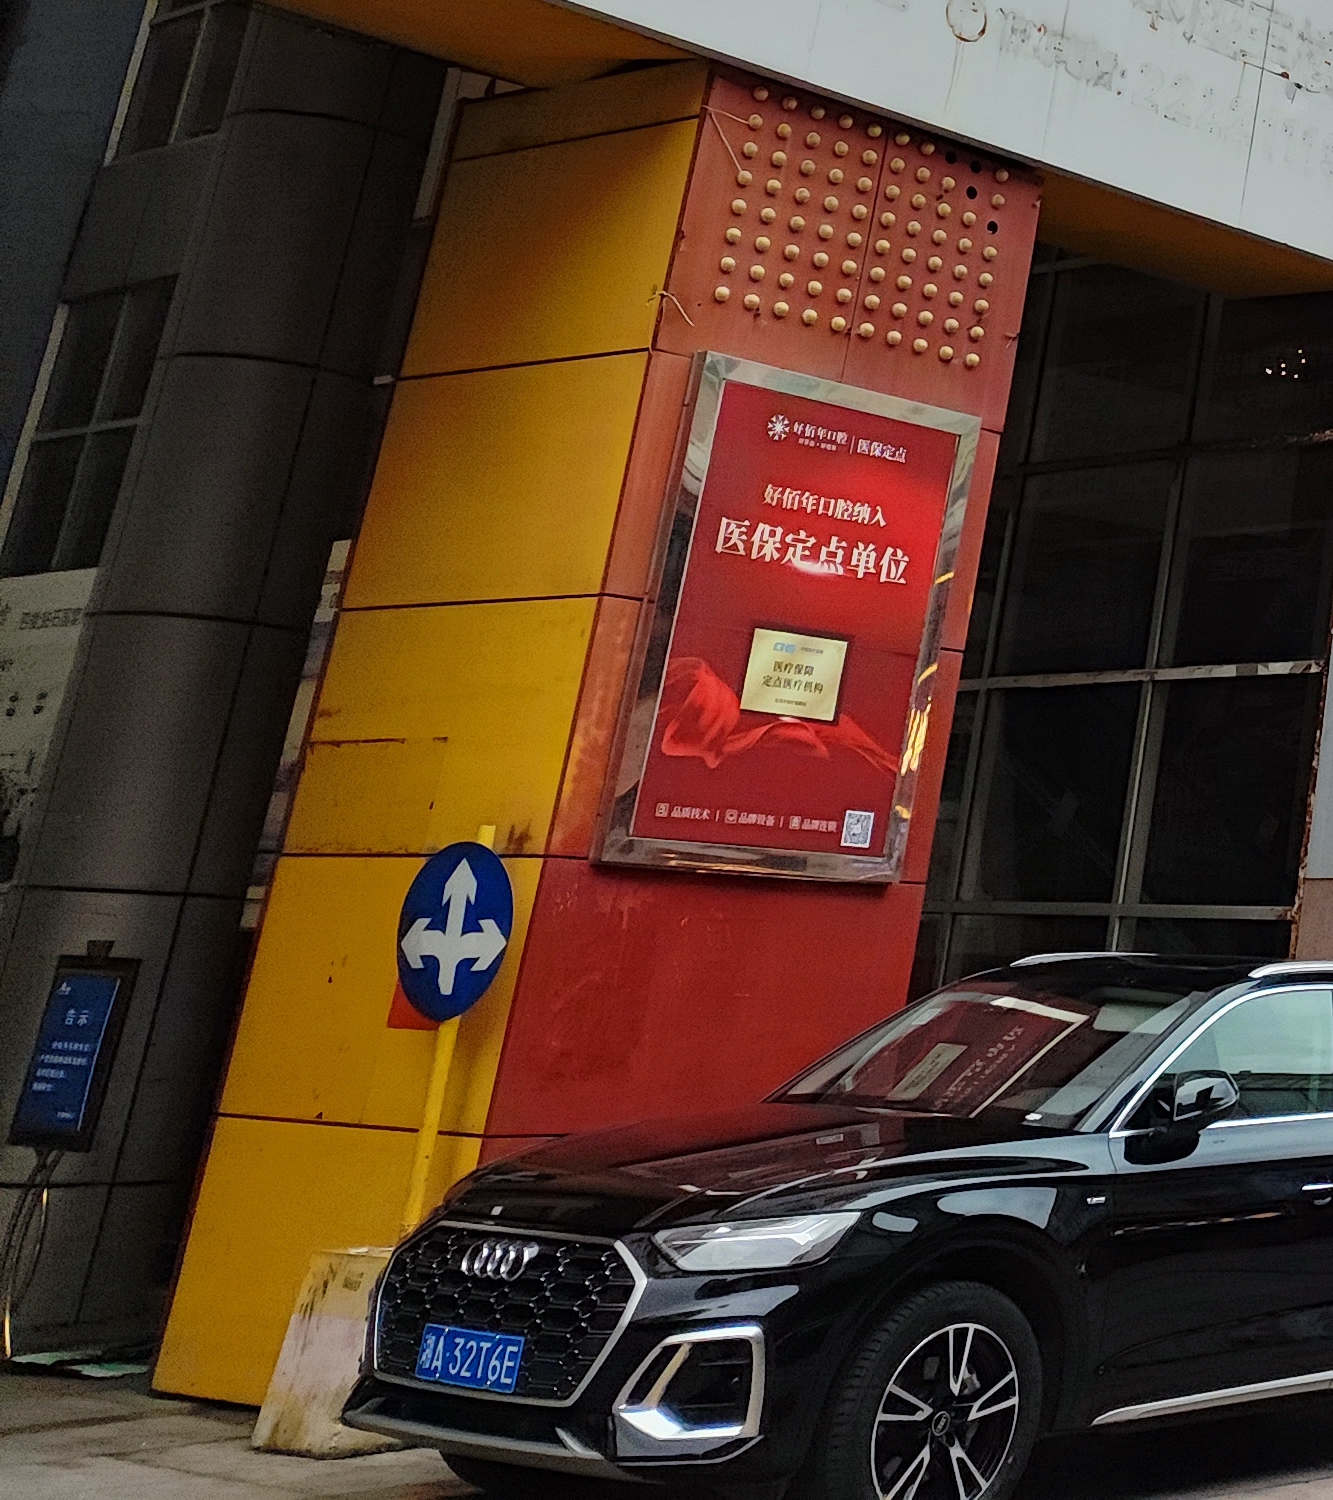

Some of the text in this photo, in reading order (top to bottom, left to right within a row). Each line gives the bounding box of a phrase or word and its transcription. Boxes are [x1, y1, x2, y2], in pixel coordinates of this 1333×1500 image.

[762, 484, 887, 528] 好佰年口腔纳入
[714, 516, 912, 586] 医保定点单位
